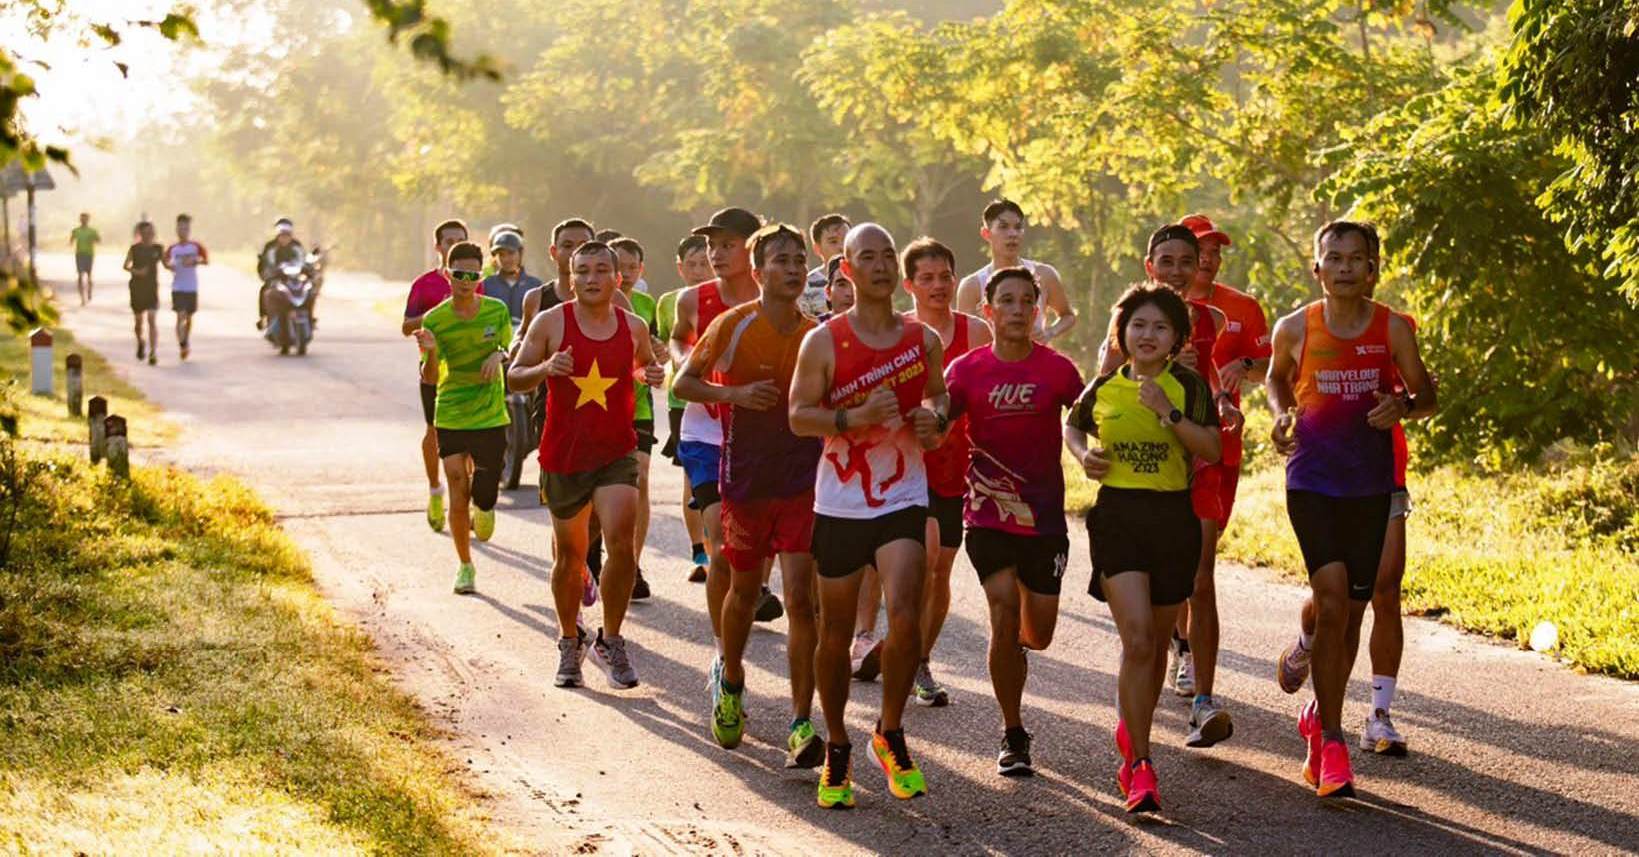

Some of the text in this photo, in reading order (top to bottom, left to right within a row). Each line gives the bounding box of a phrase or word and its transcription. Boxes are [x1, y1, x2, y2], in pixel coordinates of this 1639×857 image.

[898, 361, 925, 384] 2023
[1315, 368, 1380, 382] MARVELOUS
[1316, 382, 1341, 395] NHA
[987, 383, 1037, 409] HUE
[1112, 441, 1169, 453] AMAZING
[1133, 461, 1160, 474] 2023
